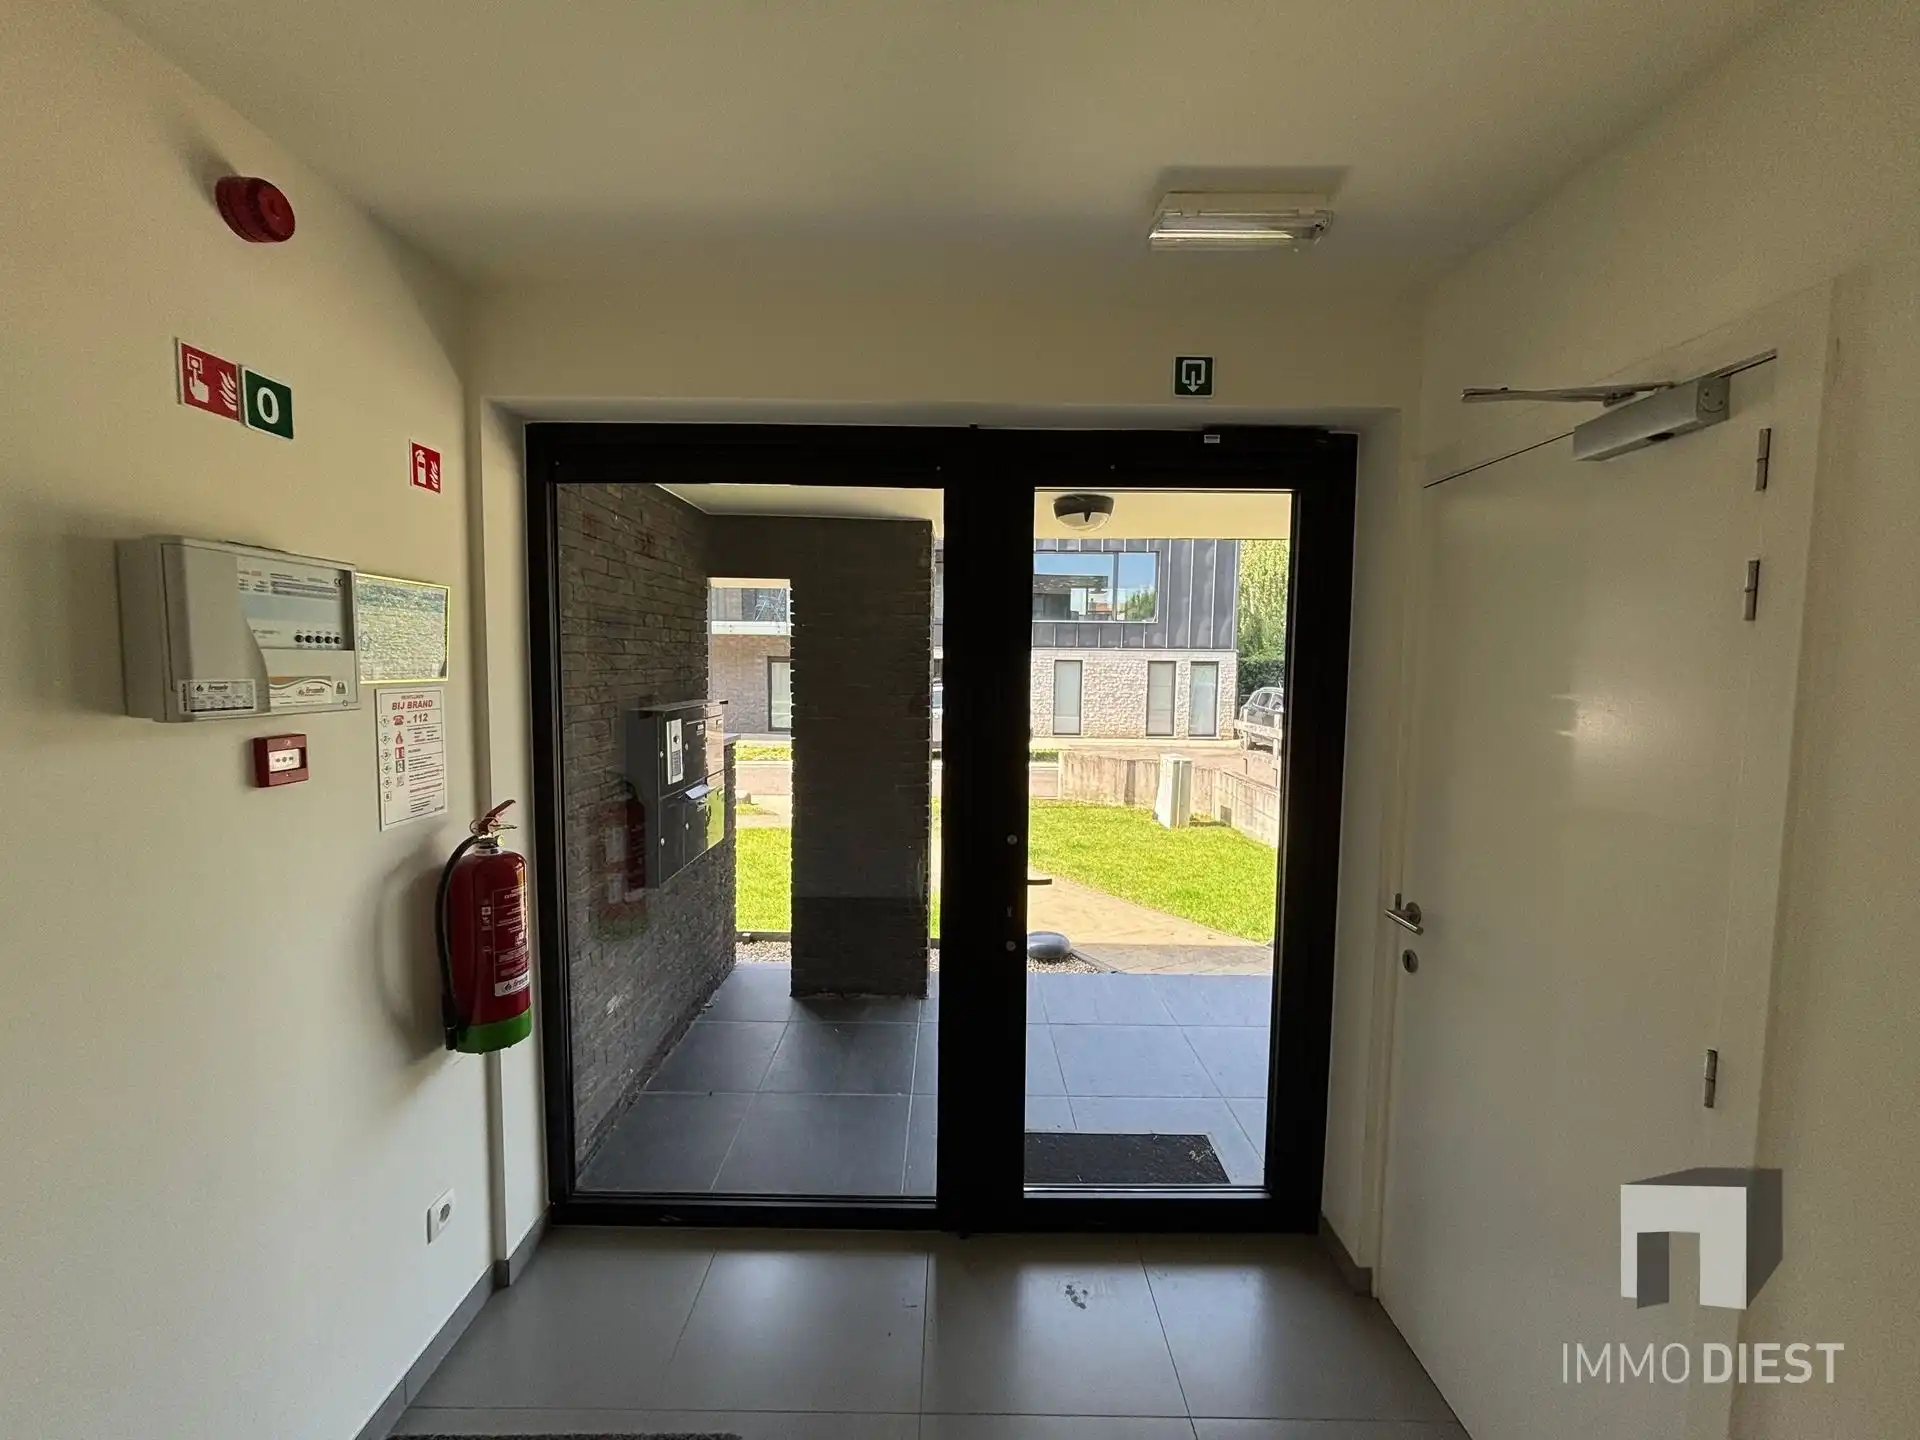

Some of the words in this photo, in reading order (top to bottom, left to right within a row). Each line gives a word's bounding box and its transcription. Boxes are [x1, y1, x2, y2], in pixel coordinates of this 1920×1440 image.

[256, 386, 280, 425] 0
[392, 702, 405, 710] BIJ
[407, 700, 433, 709] BRAND
[413, 713, 428, 723] 112
